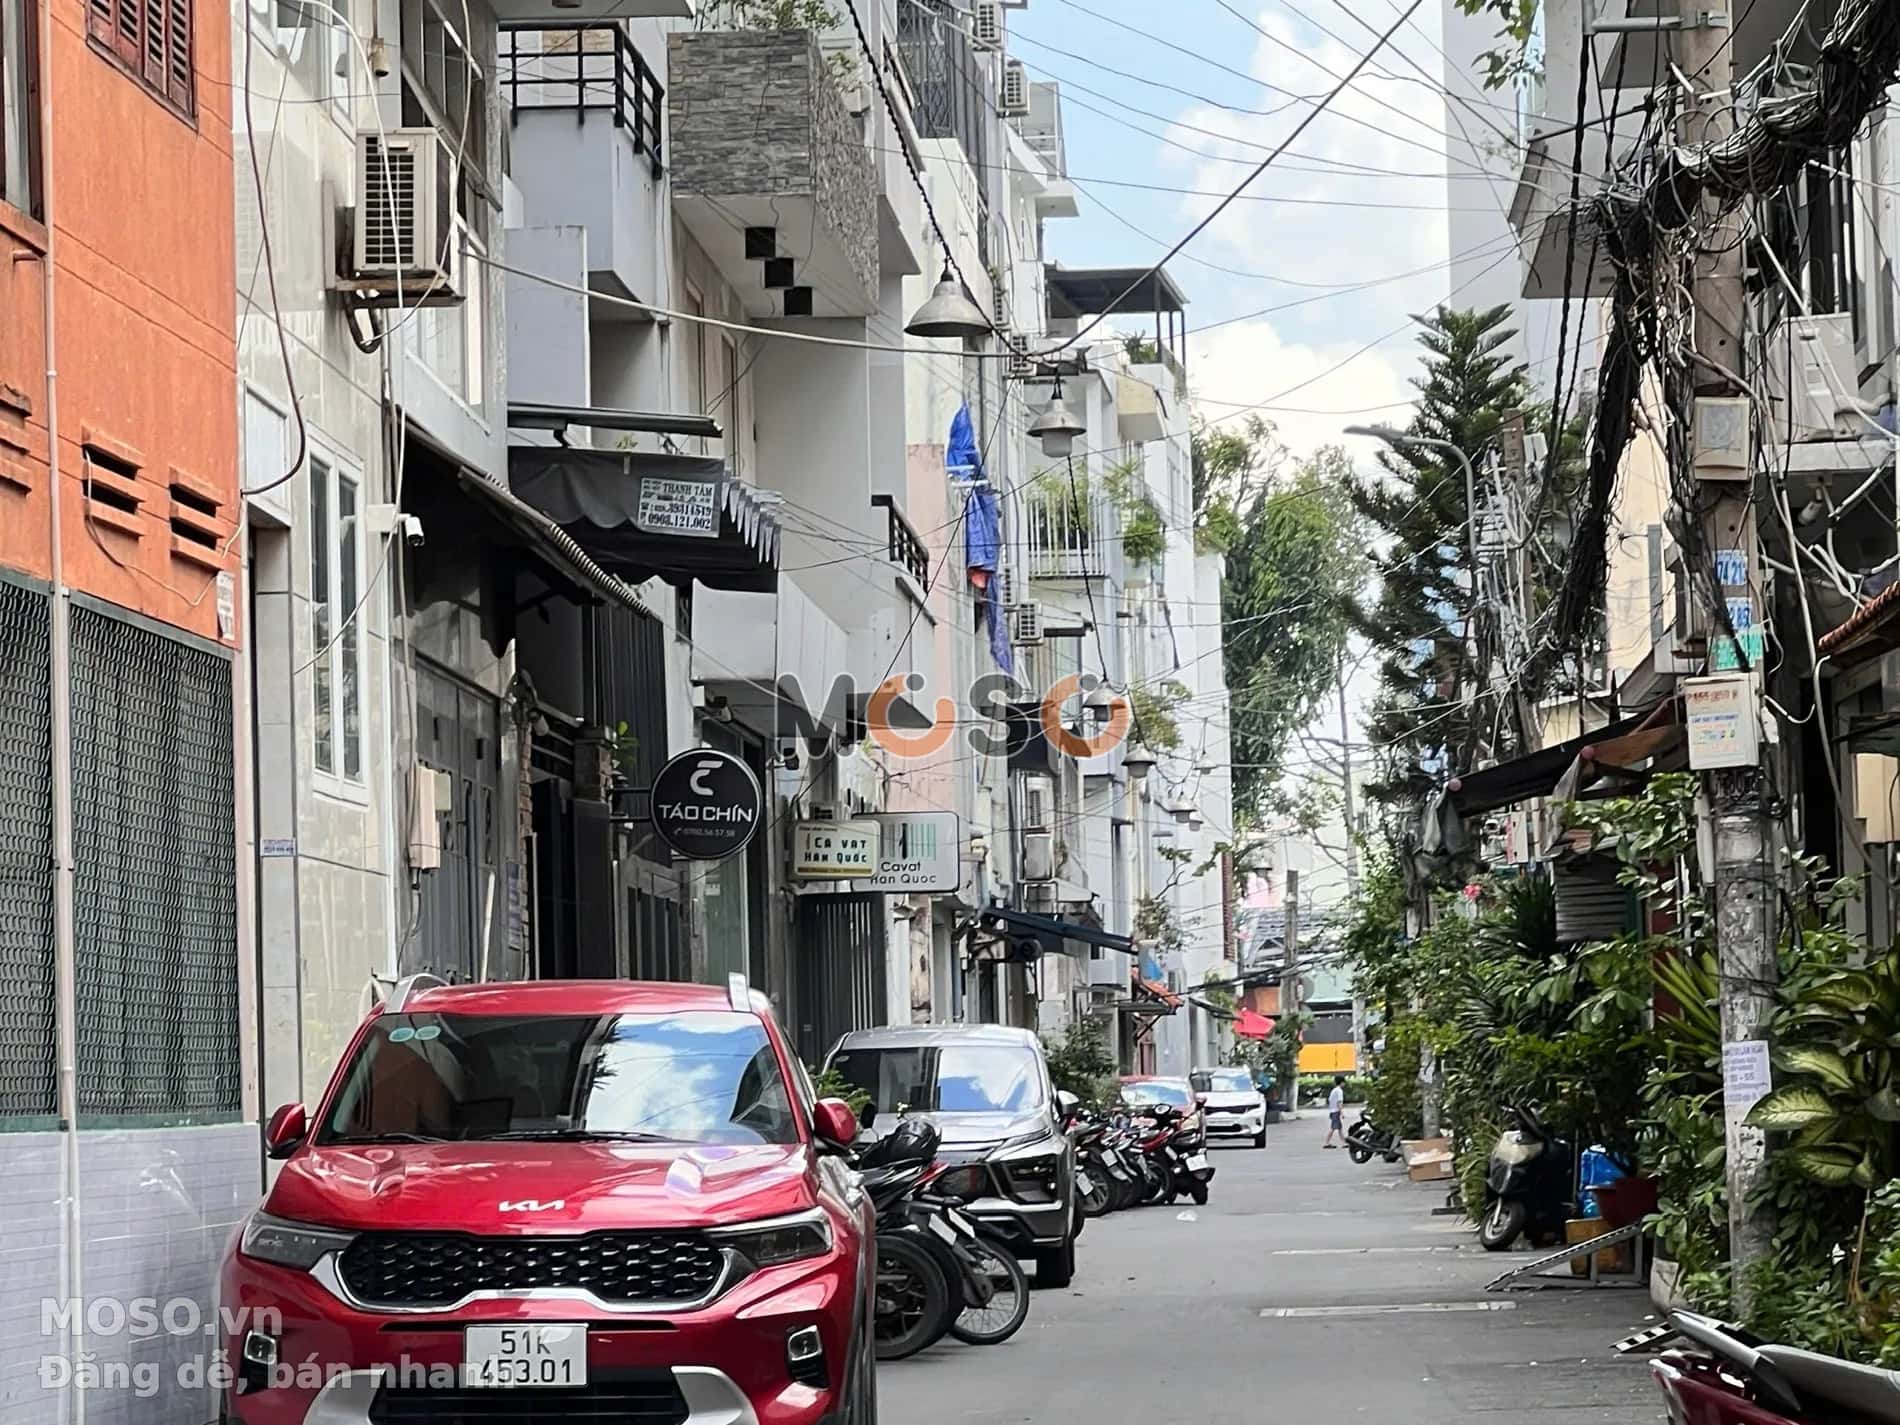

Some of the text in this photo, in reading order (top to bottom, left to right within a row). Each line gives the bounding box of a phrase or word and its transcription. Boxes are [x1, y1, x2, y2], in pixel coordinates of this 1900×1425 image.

[658, 802, 753, 823] TÁO CHÍN
[501, 1330, 551, 1354] 51K
[480, 1358, 572, 1384] 453.01
